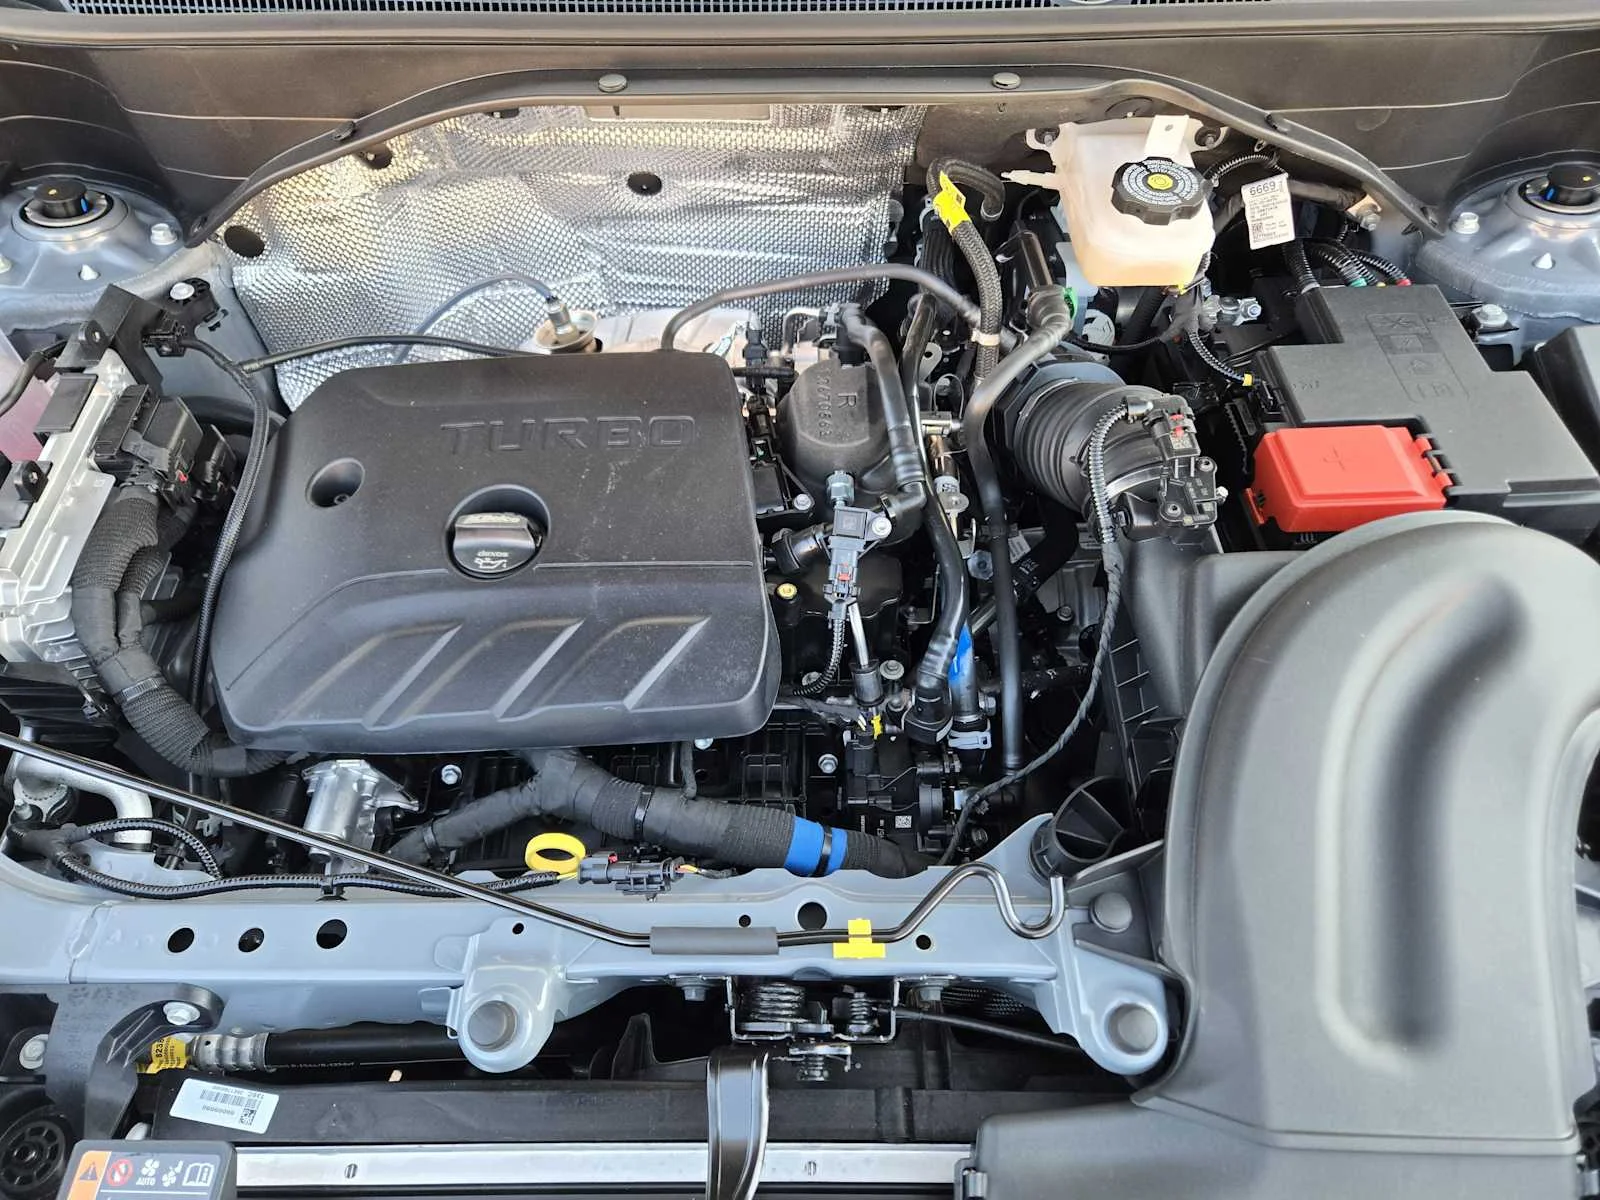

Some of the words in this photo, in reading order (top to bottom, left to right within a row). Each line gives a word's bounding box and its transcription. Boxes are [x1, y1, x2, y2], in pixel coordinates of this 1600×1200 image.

[1249, 181, 1276, 196] 6669
[837, 392, 857, 408] R
[440, 415, 695, 454] TURBO
[136, 1177, 156, 1186] AUTO
